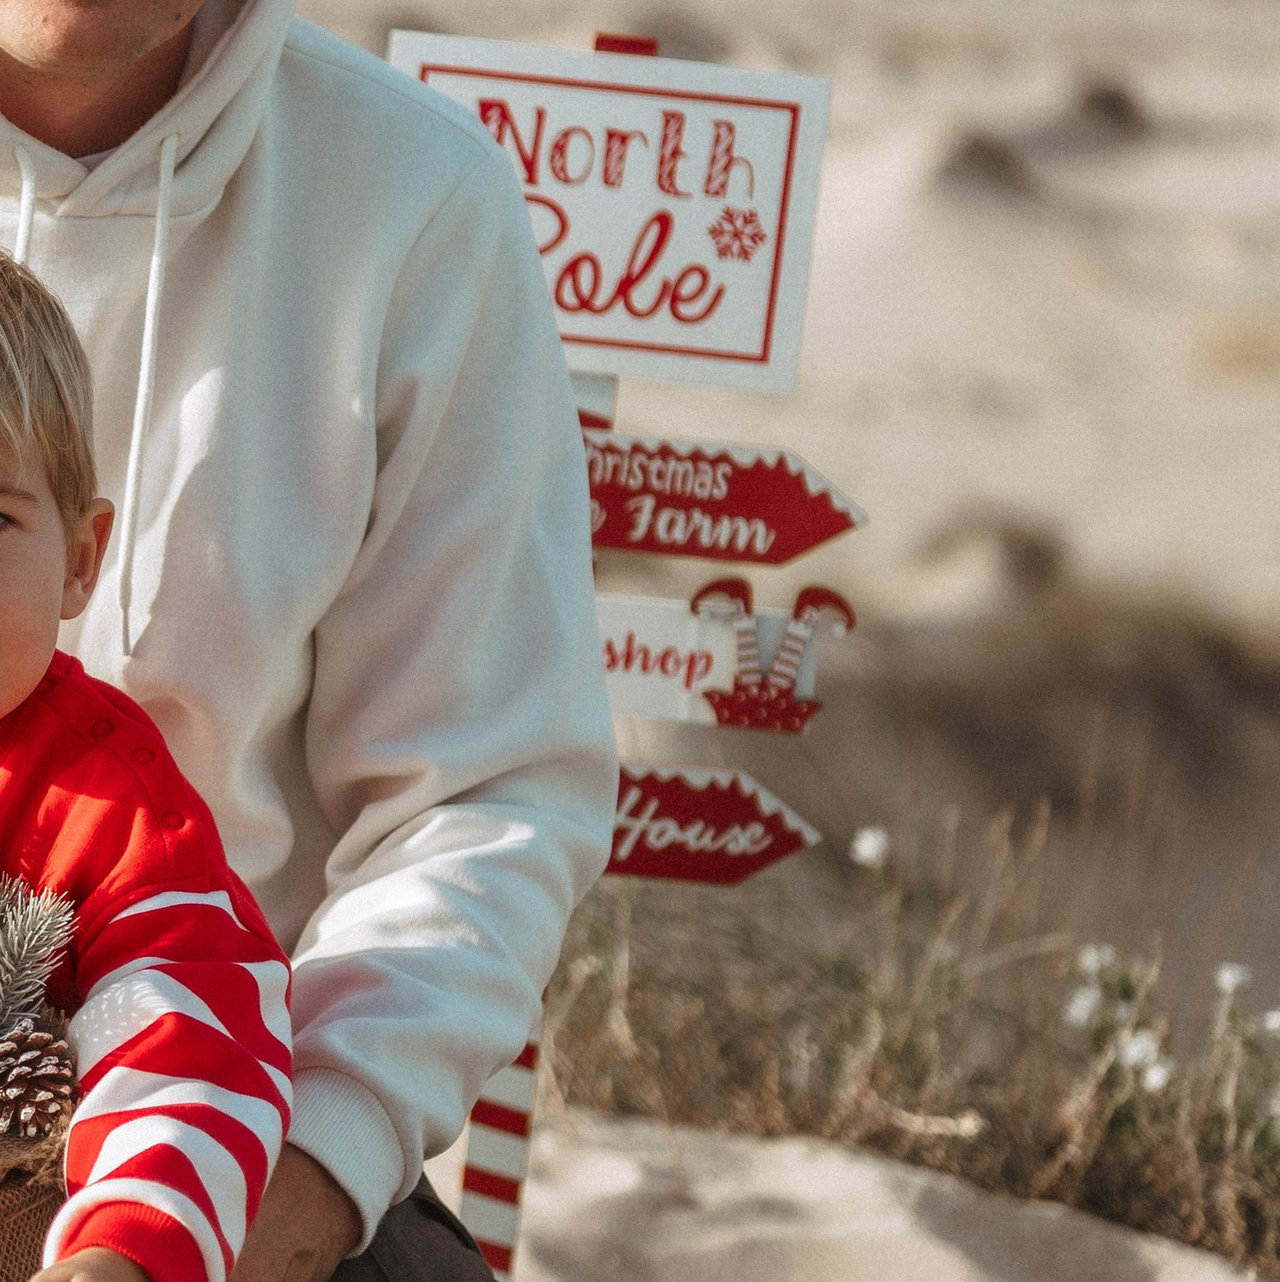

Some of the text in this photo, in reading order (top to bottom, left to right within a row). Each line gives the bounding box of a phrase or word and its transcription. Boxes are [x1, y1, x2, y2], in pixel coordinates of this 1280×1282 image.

[478, 99, 756, 200] North
[626, 494, 776, 553] Farm
[614, 786, 773, 859] House
